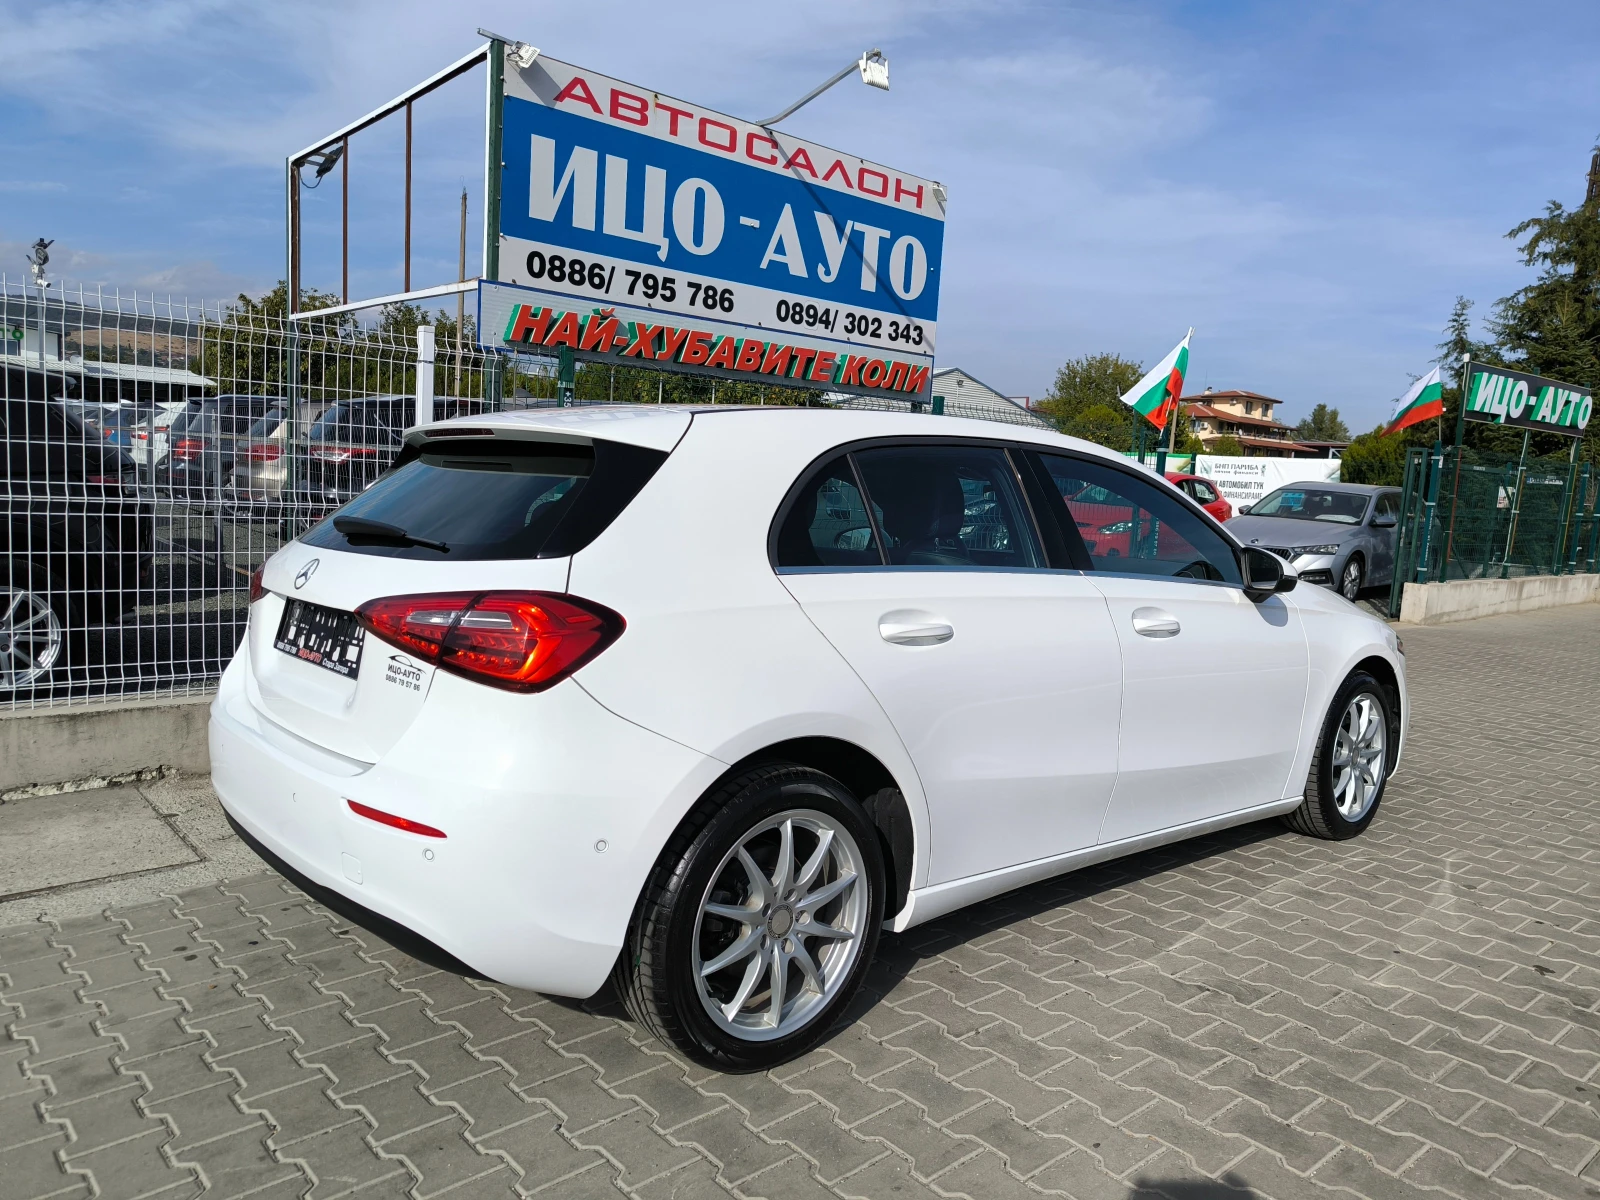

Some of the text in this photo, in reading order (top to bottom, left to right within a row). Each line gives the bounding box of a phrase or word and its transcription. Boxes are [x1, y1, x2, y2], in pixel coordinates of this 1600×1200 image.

[553, 76, 925, 209] АВТОСАЛОН
[526, 250, 736, 313] 0886/ 795 786
[505, 302, 930, 395] НАЙ-ХУБАВИТЕ КОЛИ
[775, 299, 924, 346] 0894/ 302 343
[1469, 371, 1593, 430] ИЦО-АУТО
[1218, 480, 1253, 490] АВТОМОБИЛ
[1253, 481, 1264, 490] ТУК
[387, 663, 421, 681] ИЦО-АУТО
[398, 678, 405, 686] 79
[405, 680, 413, 688] 57
